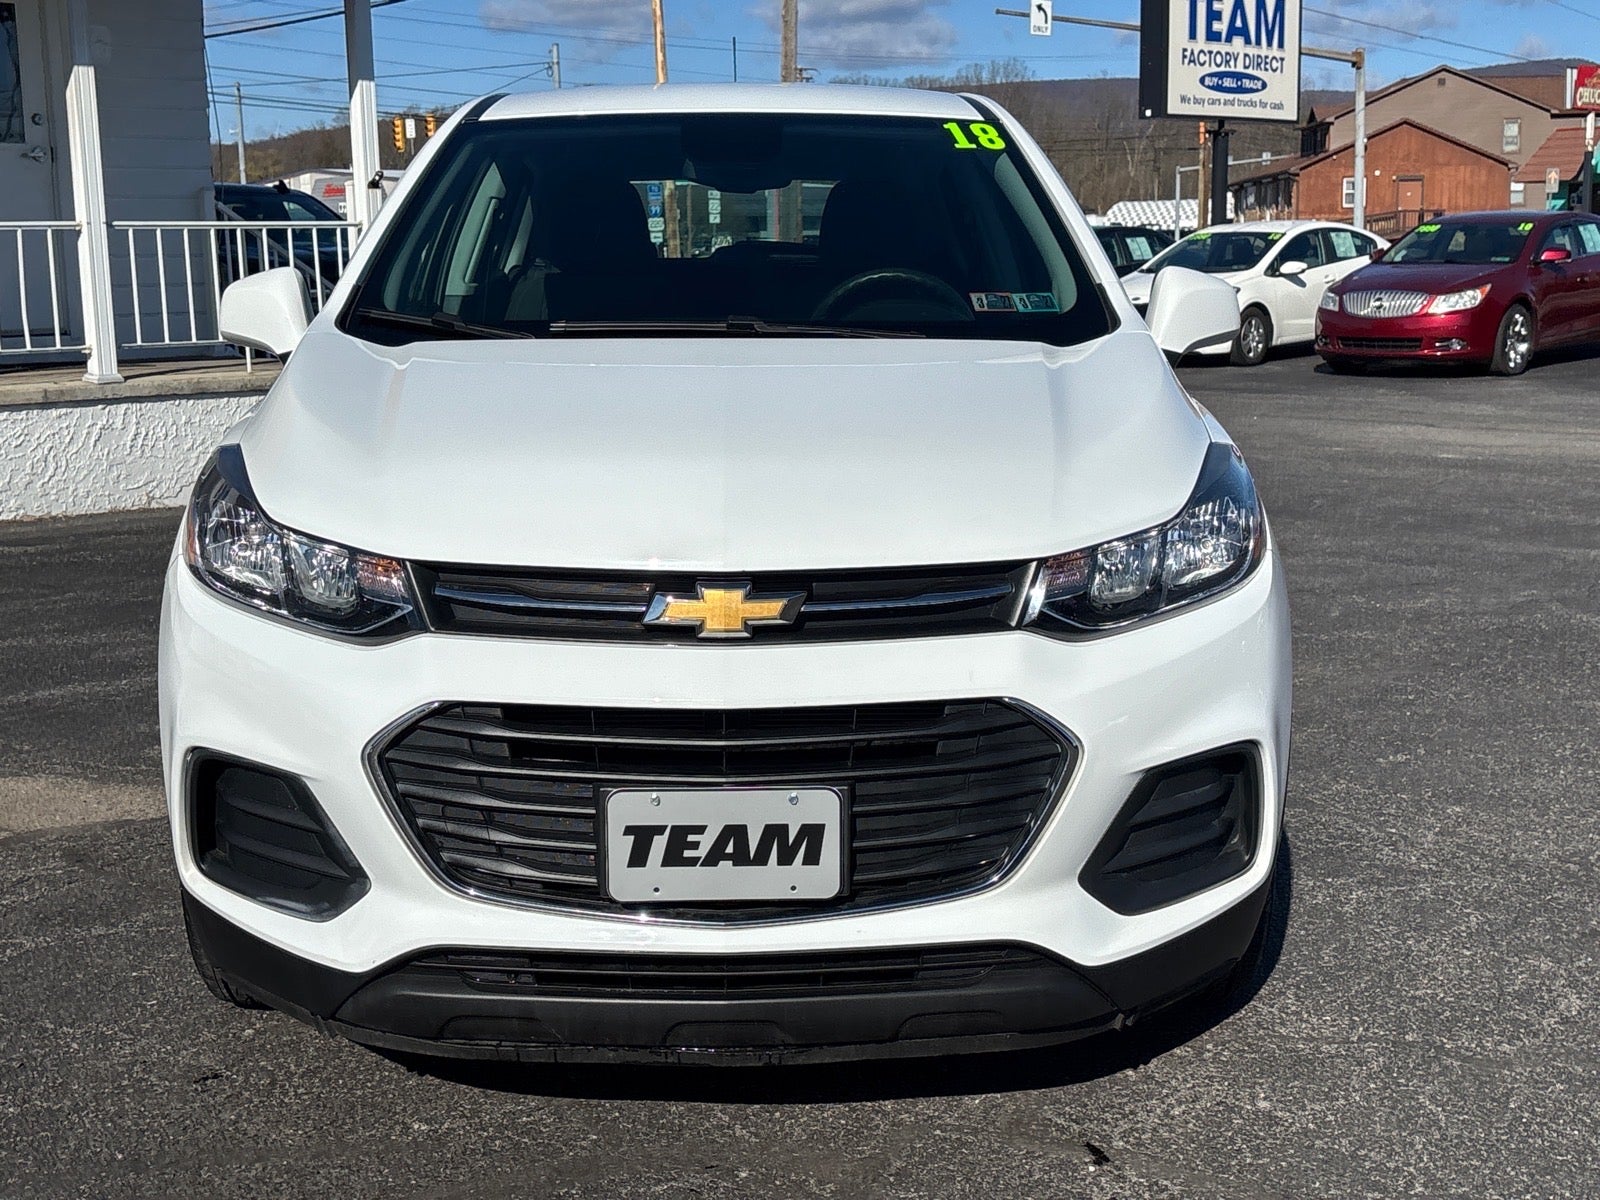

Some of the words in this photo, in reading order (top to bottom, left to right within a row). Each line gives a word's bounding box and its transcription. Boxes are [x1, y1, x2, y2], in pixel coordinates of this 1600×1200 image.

[1033, 25, 1048, 33] ONLY
[1188, 0, 1285, 50] TEAM
[1181, 48, 1240, 69] FACTORY
[1243, 52, 1285, 74] DIRECT
[1204, 76, 1219, 87] BUY
[1222, 77, 1238, 88] SELL
[1242, 78, 1262, 89] TRADE
[1180, 94, 1191, 105] We
[1193, 95, 1205, 107] buy
[1207, 97, 1221, 107] cars
[1223, 97, 1236, 107] and
[1237, 98, 1257, 108] trucks
[1259, 99, 1268, 109] for
[1269, 100, 1285, 111] cash
[943, 122, 1006, 150] 18
[976, 297, 985, 309] 3
[1019, 297, 1029, 309] 3
[622, 823, 826, 868] TEAM
